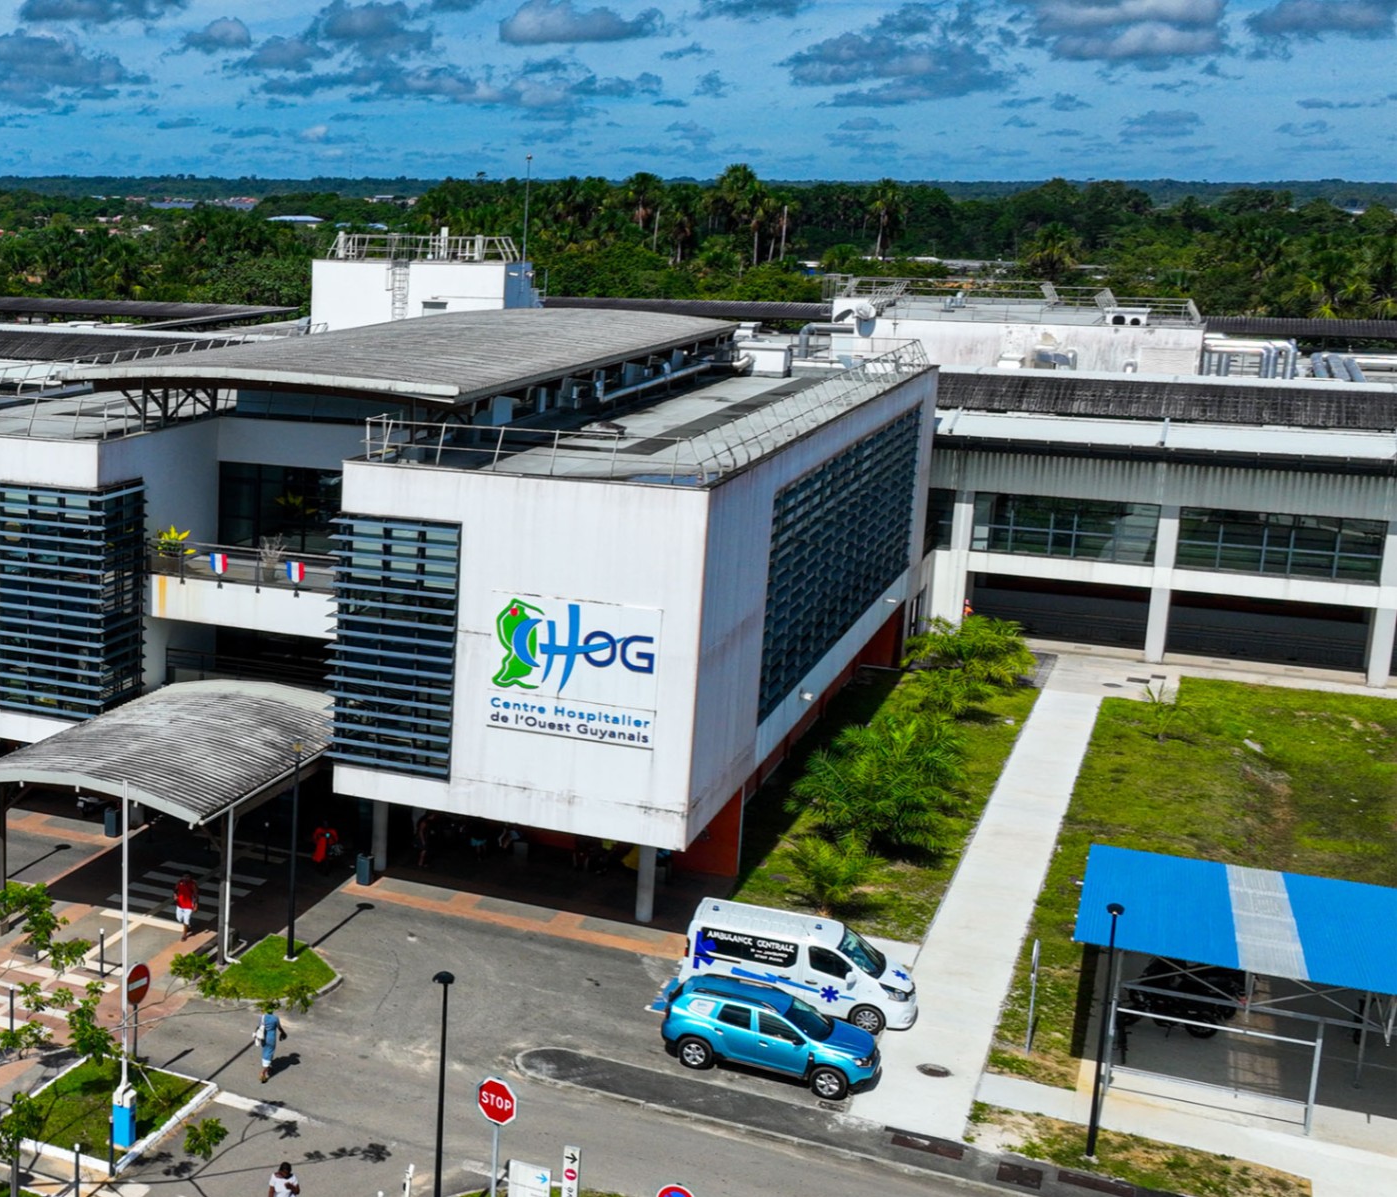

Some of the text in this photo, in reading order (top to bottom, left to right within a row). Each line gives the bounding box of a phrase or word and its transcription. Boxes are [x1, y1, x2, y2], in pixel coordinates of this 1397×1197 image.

[513, 604, 655, 693] CHOG
[490, 697, 651, 728] Centre Hospitalier
[490, 711, 649, 743] de l'Ouest Guyanais
[706, 930, 753, 946] AMBULANCE
[756, 939, 795, 953] CENTRALE
[481, 1091, 513, 1112] STOP
